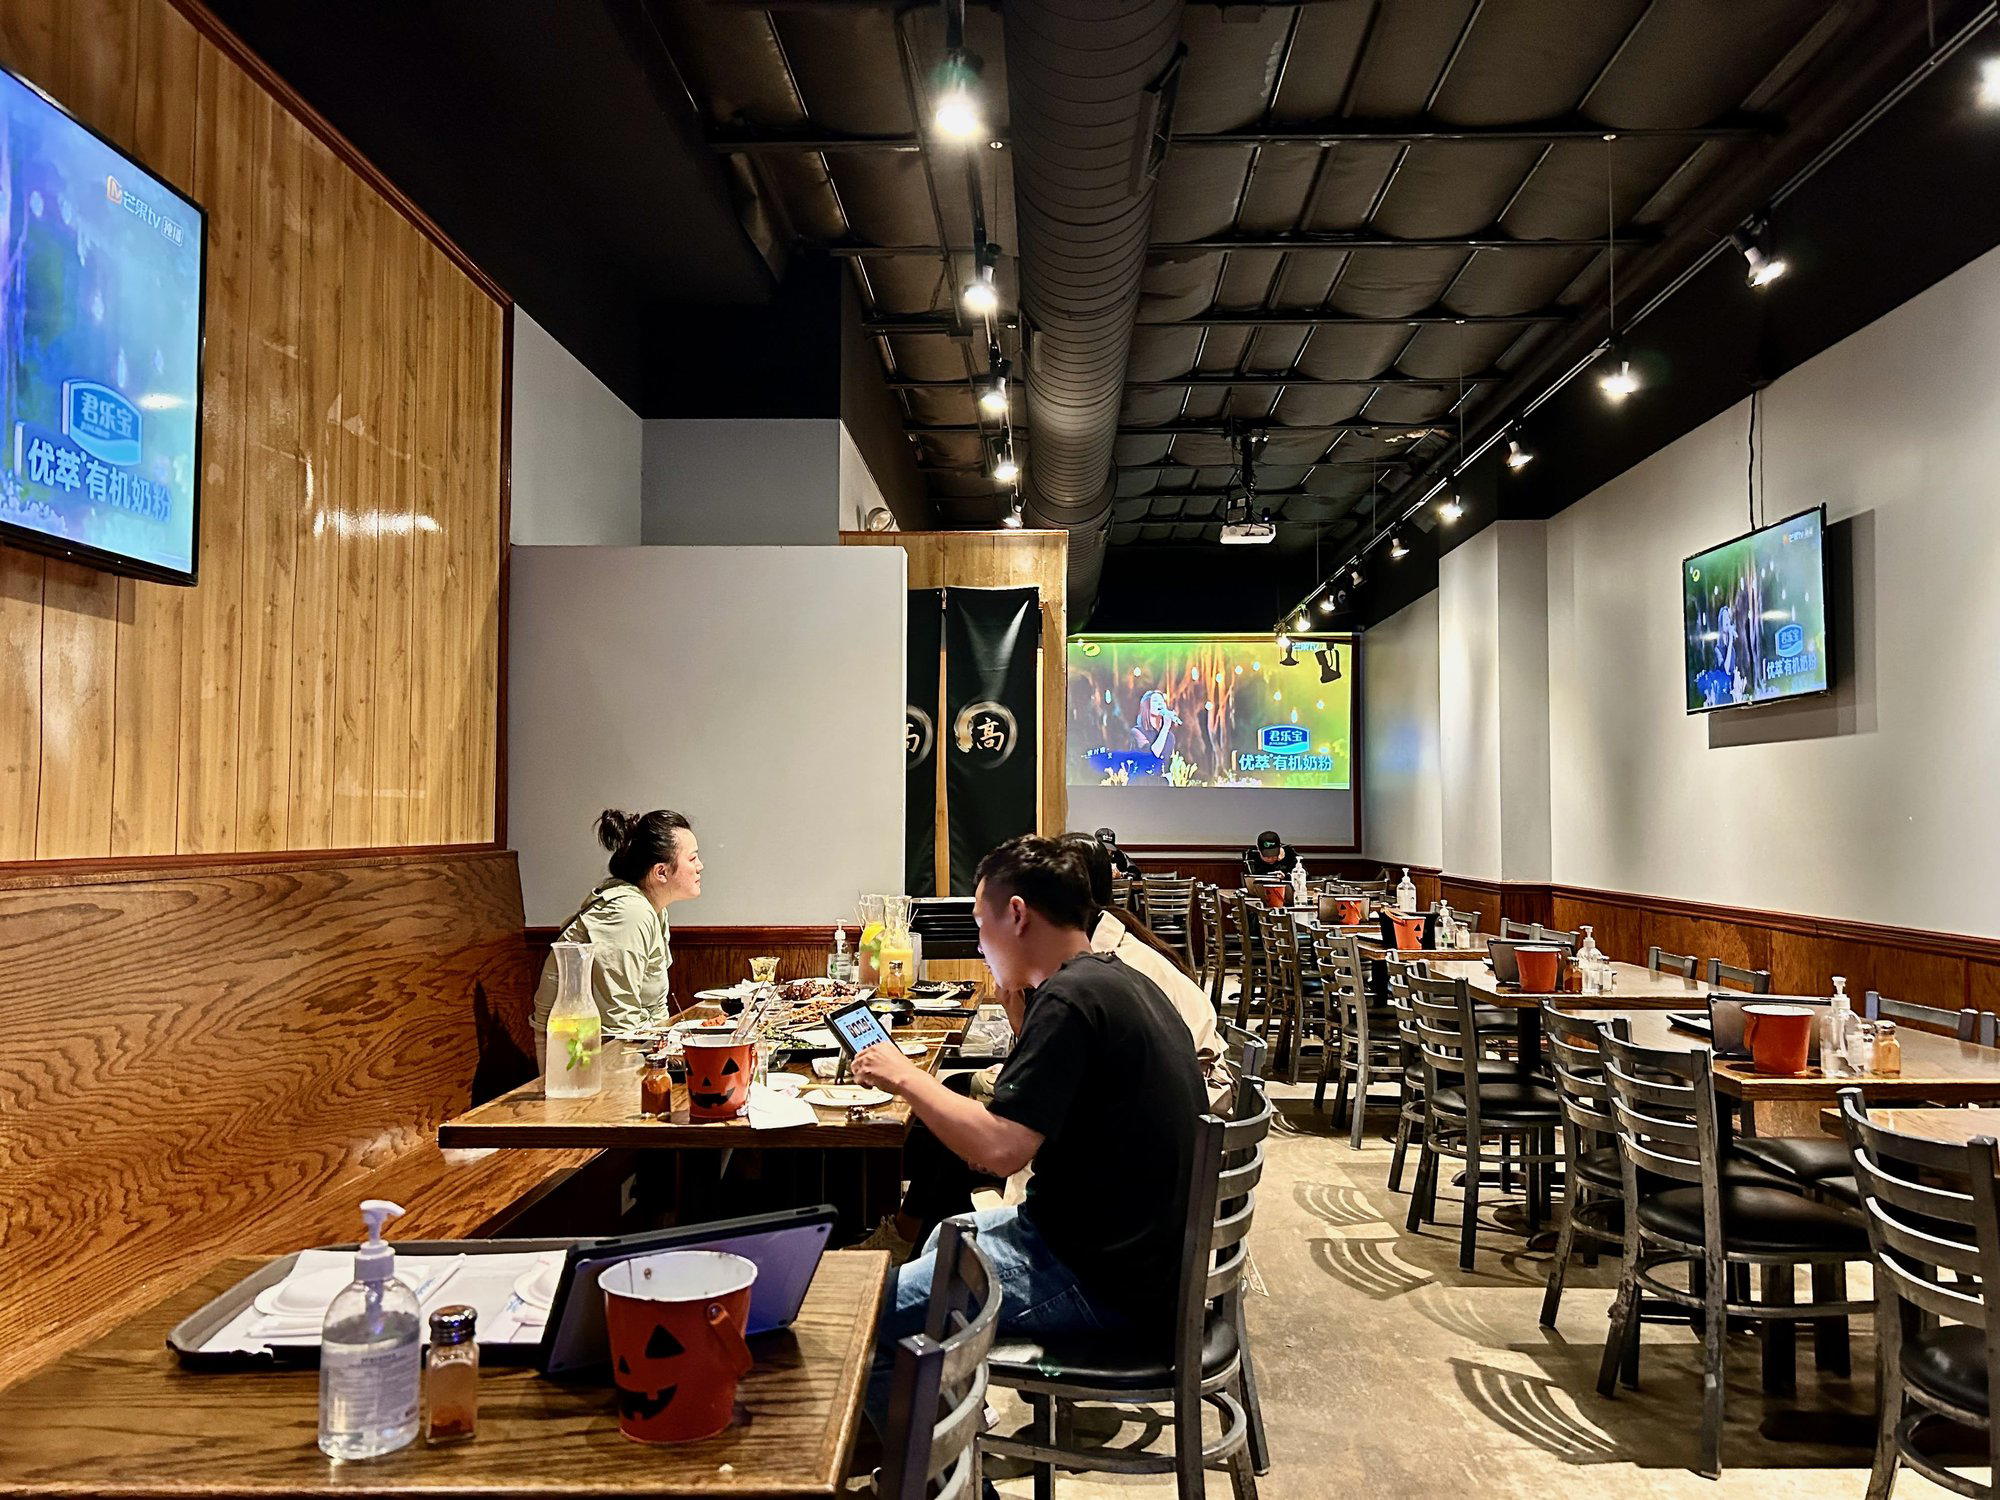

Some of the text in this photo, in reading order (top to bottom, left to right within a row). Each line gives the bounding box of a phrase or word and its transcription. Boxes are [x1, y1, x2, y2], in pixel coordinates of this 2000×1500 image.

[81, 391, 132, 438] 君乐宝
[1269, 730, 1303, 742] 君乐宝
